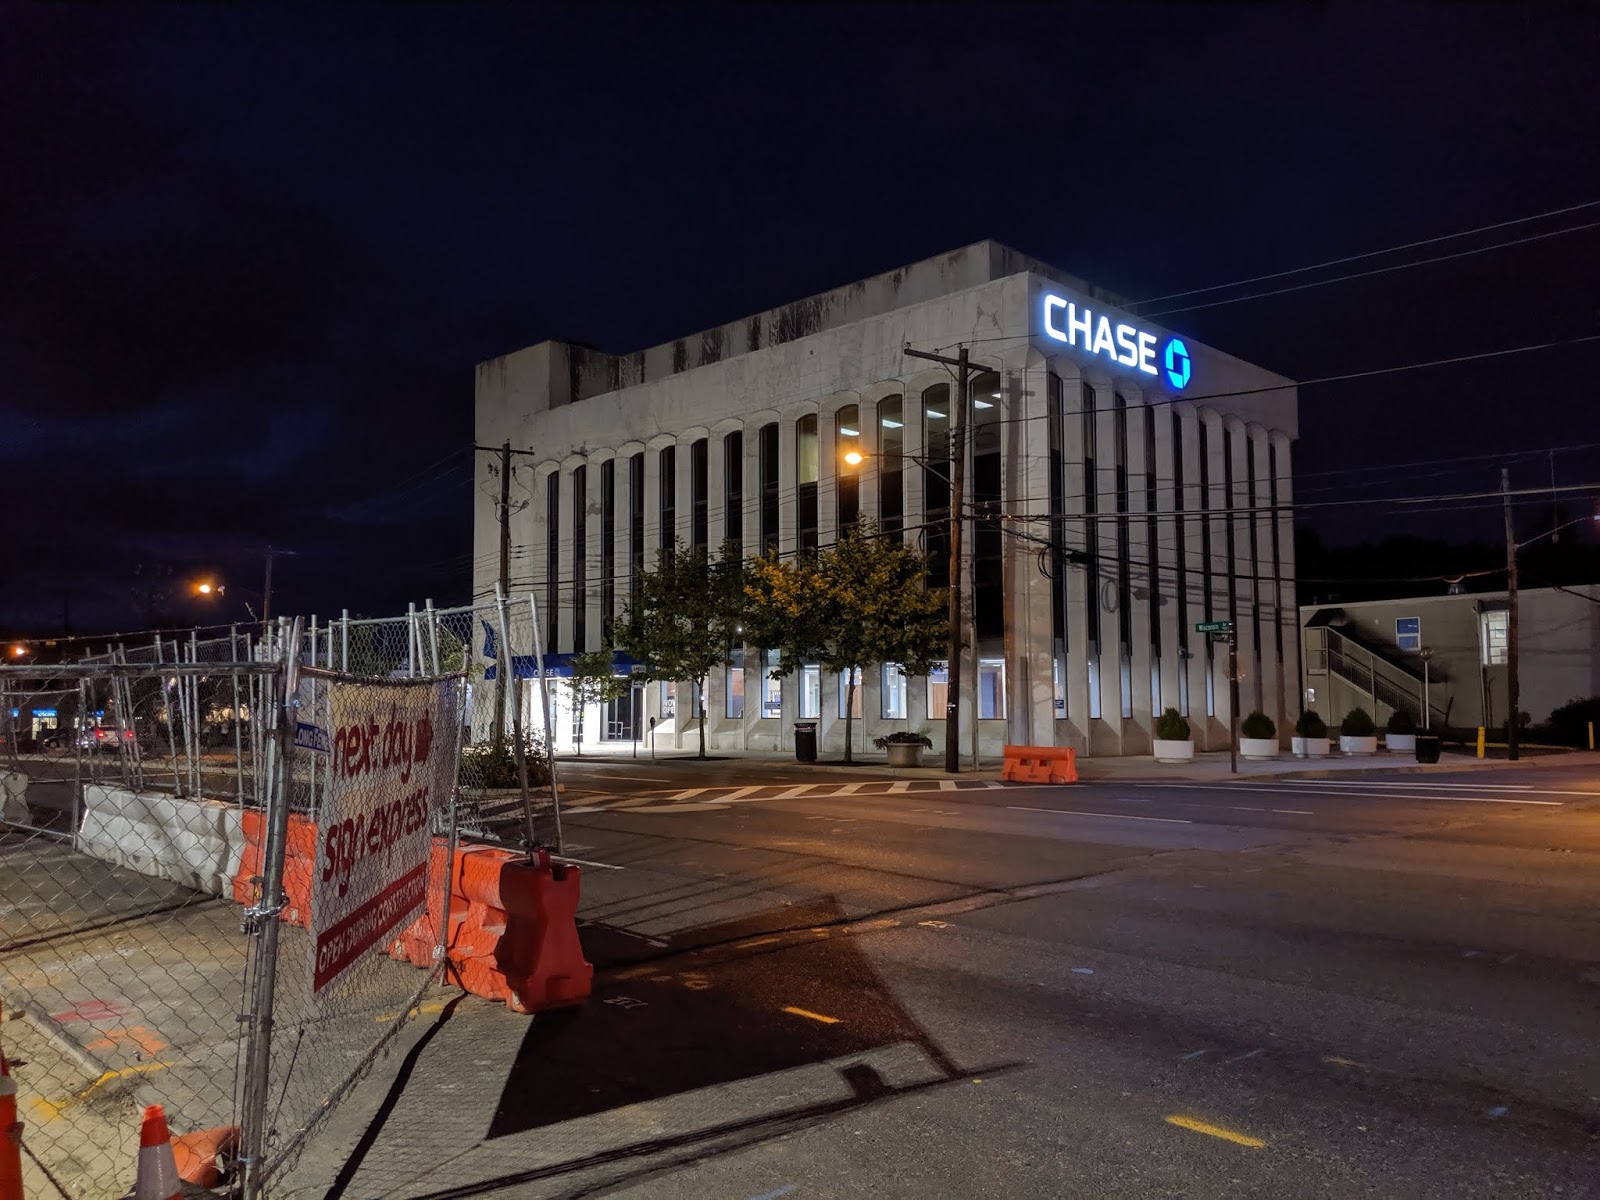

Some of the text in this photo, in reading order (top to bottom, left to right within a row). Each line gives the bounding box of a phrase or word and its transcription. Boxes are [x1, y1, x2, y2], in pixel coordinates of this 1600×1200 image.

[1044, 294, 1159, 376] CHASE
[533, 669, 554, 677] CSE
[663, 706, 675, 714] OPE
[333, 699, 413, 784] next day
[322, 786, 428, 898] sign express
[319, 930, 345, 972] OPEN
